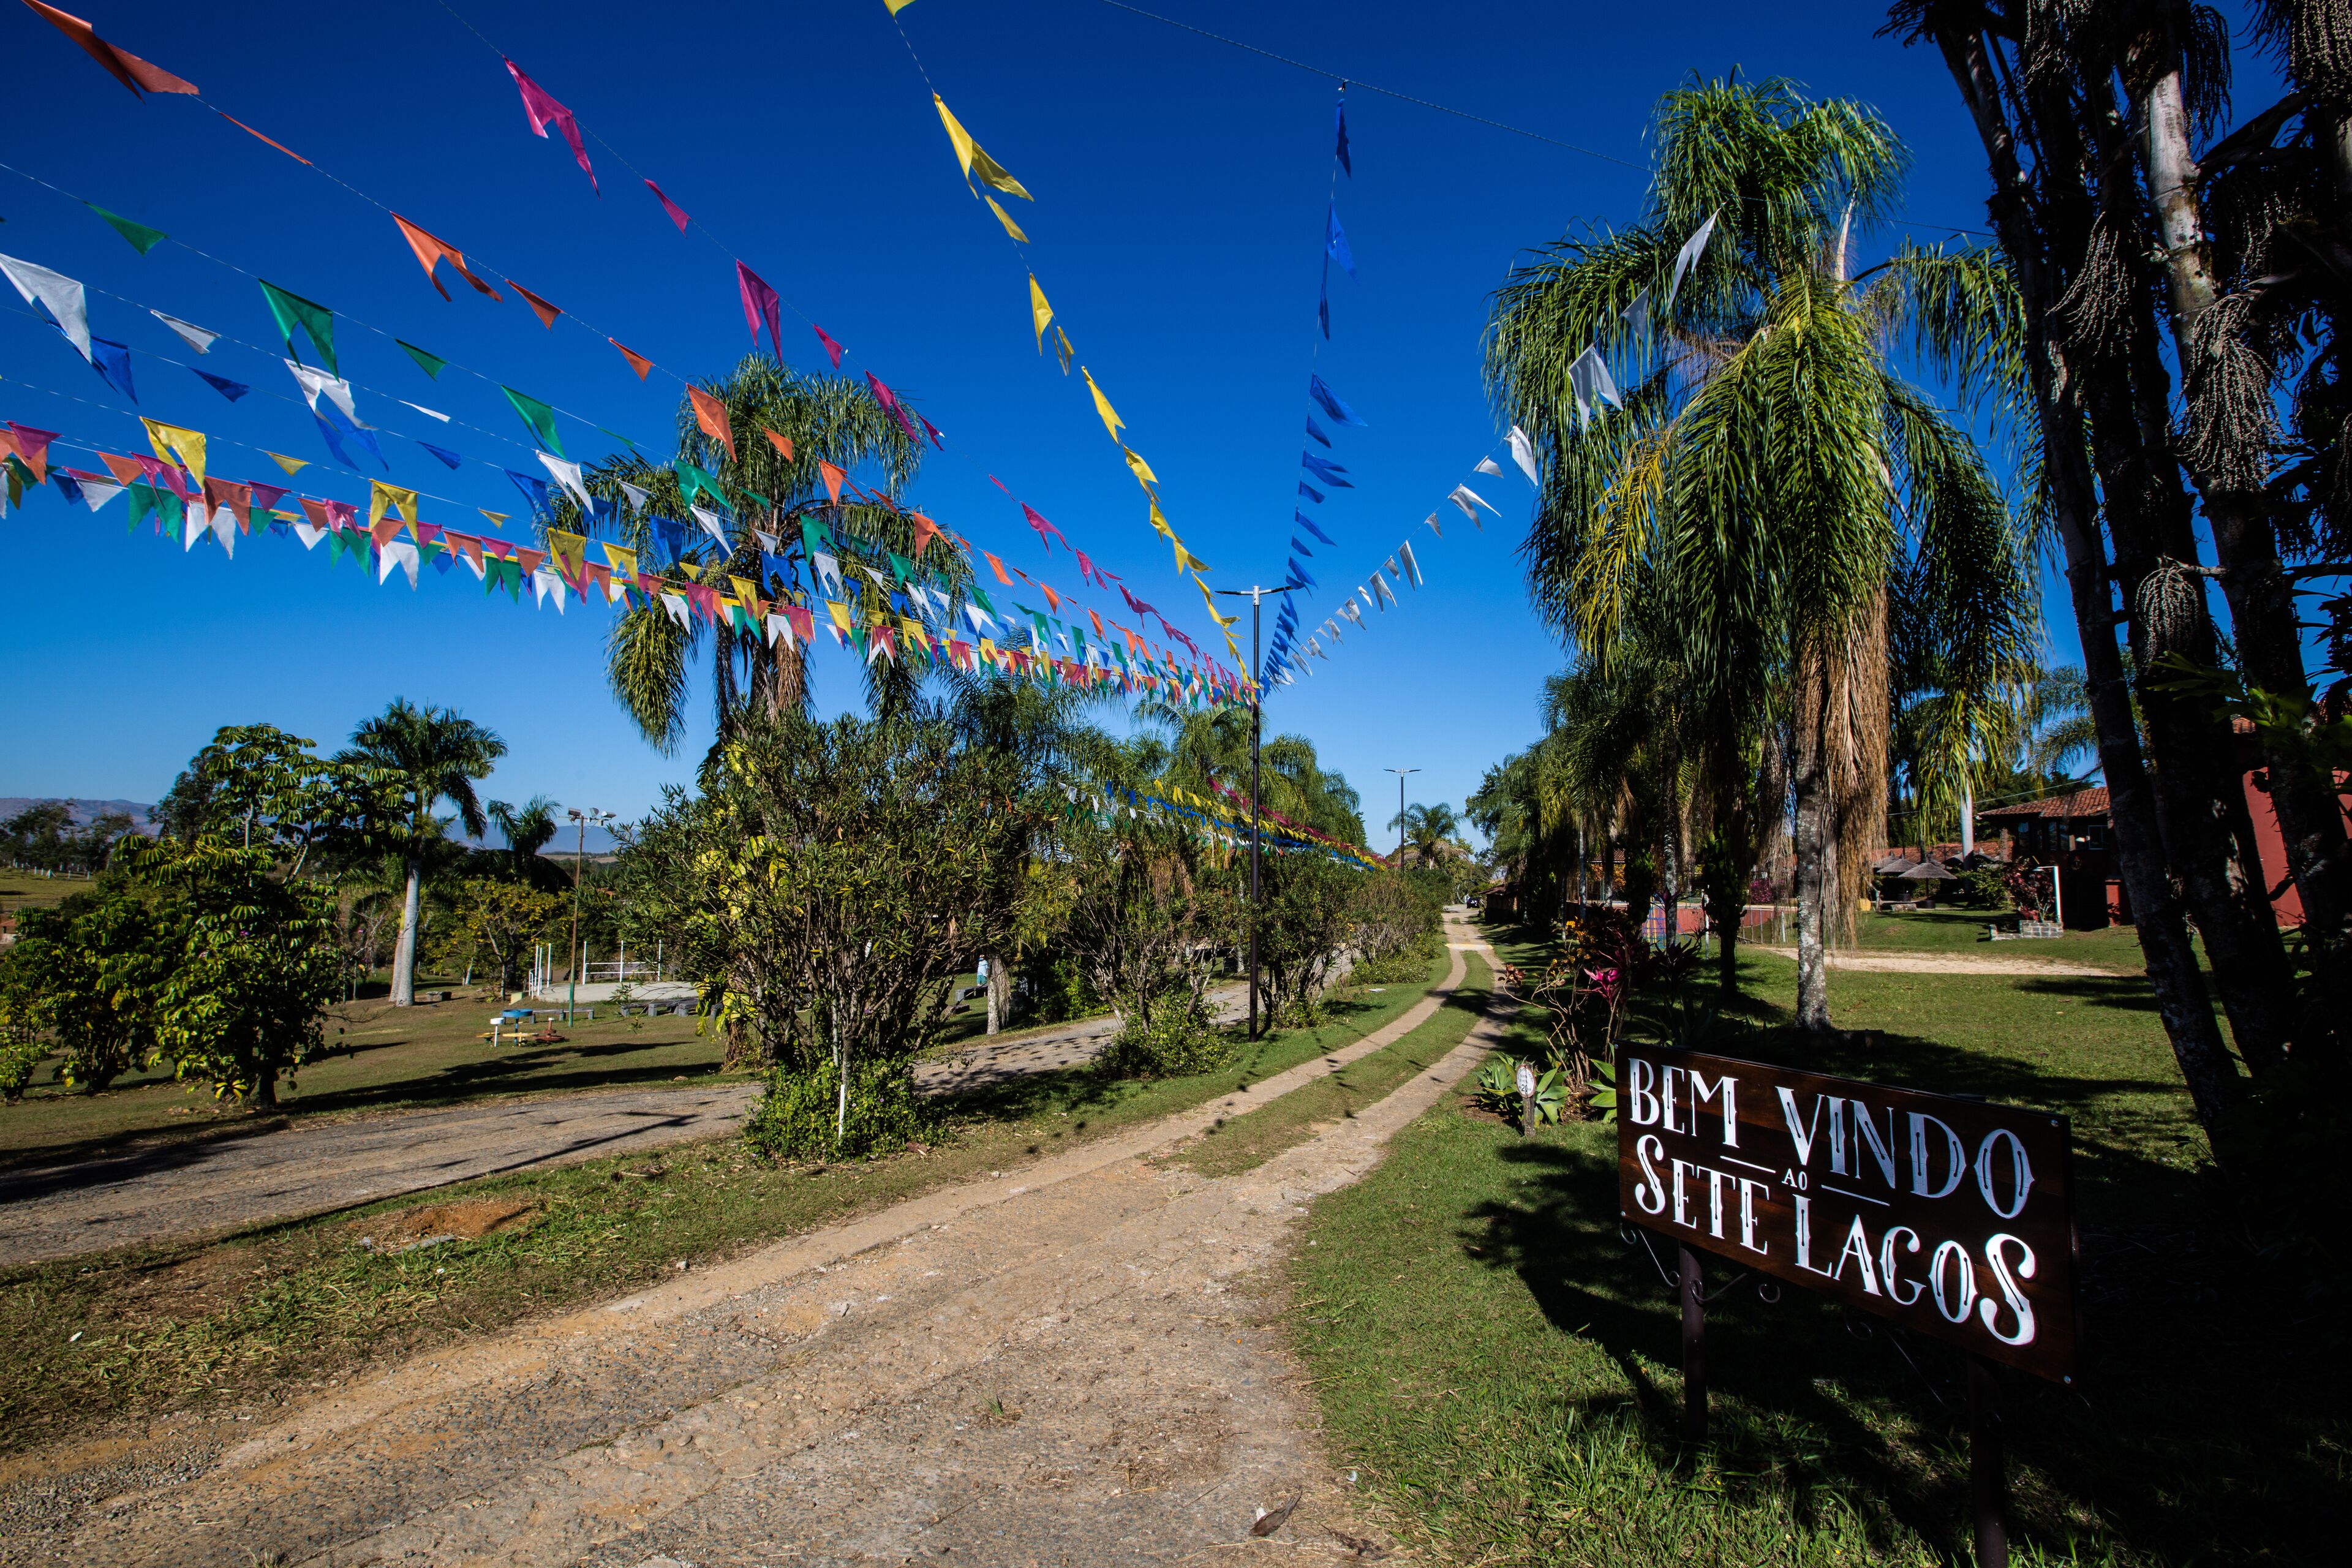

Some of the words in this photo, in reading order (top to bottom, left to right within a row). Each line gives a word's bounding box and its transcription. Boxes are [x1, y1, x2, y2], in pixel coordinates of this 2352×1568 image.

[1629, 1058, 1740, 1148] BEM
[1774, 1085, 2035, 1219] VINDO
[1781, 1167, 1807, 1191] AO
[1635, 1134, 1771, 1256] SETE
[1792, 1194, 2037, 1346] LAGOS
